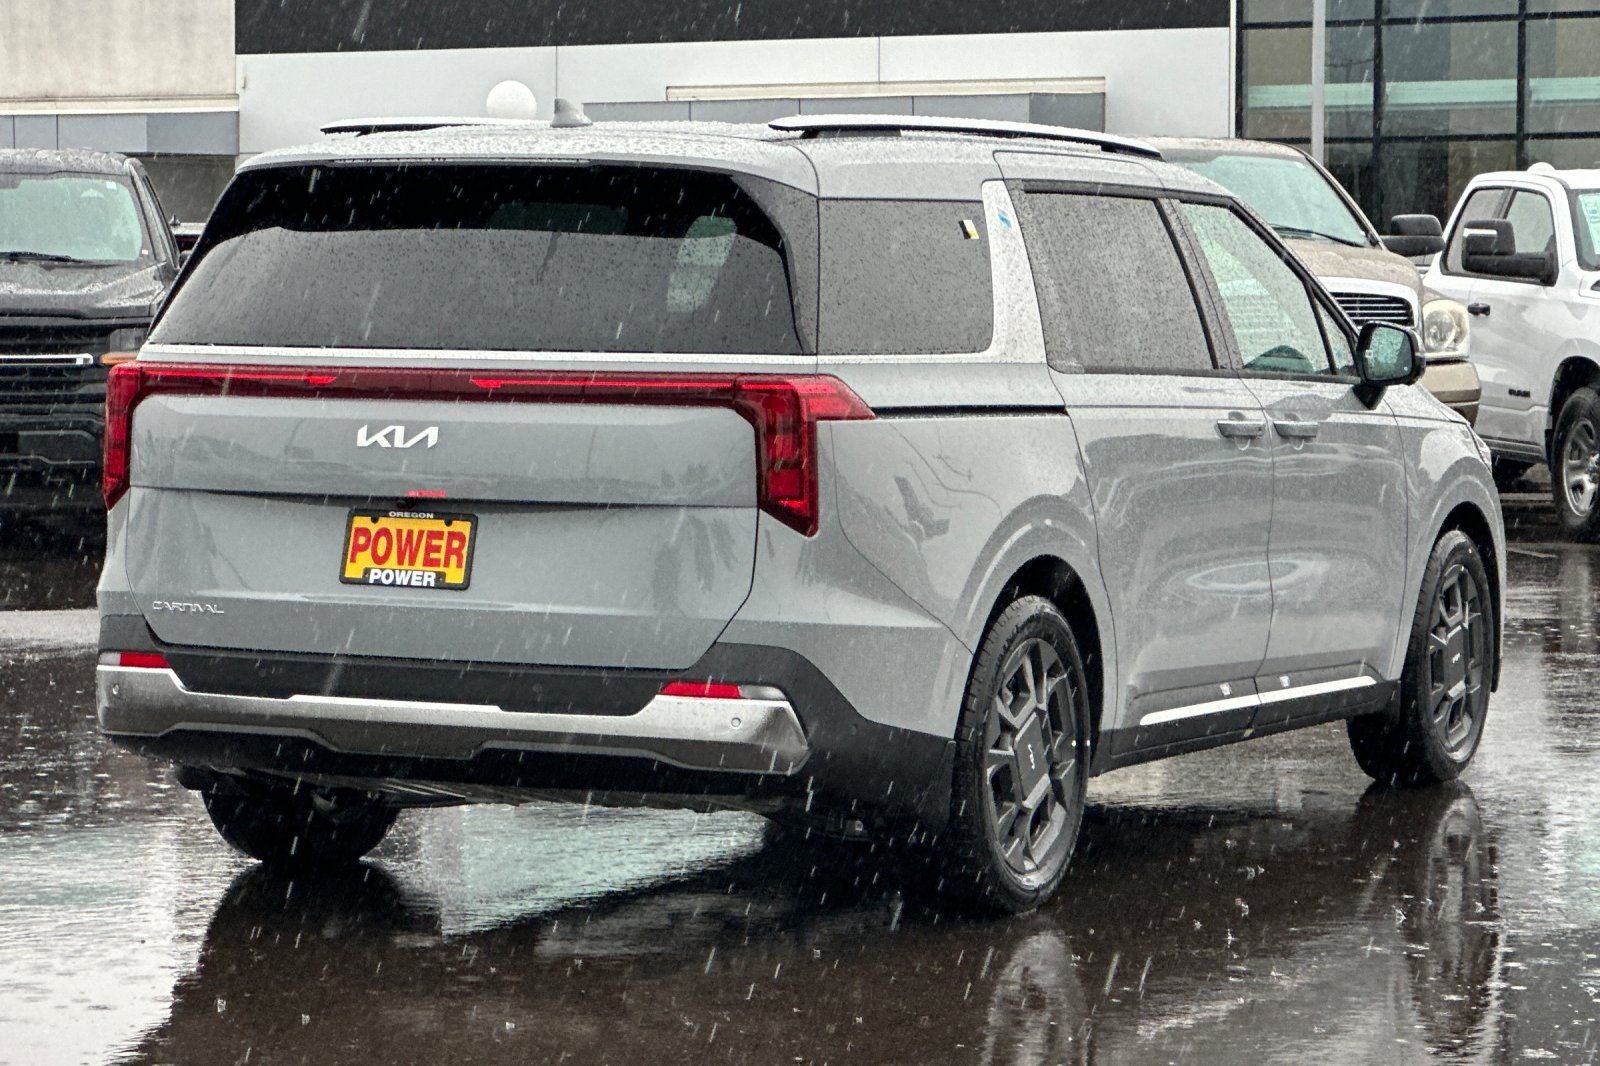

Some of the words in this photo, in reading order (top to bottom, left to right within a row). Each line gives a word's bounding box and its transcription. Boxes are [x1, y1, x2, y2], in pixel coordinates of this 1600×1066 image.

[357, 424, 439, 448] KIA
[388, 510, 434, 519] OREGON
[349, 526, 467, 569] POWER
[368, 568, 437, 587] POWER
